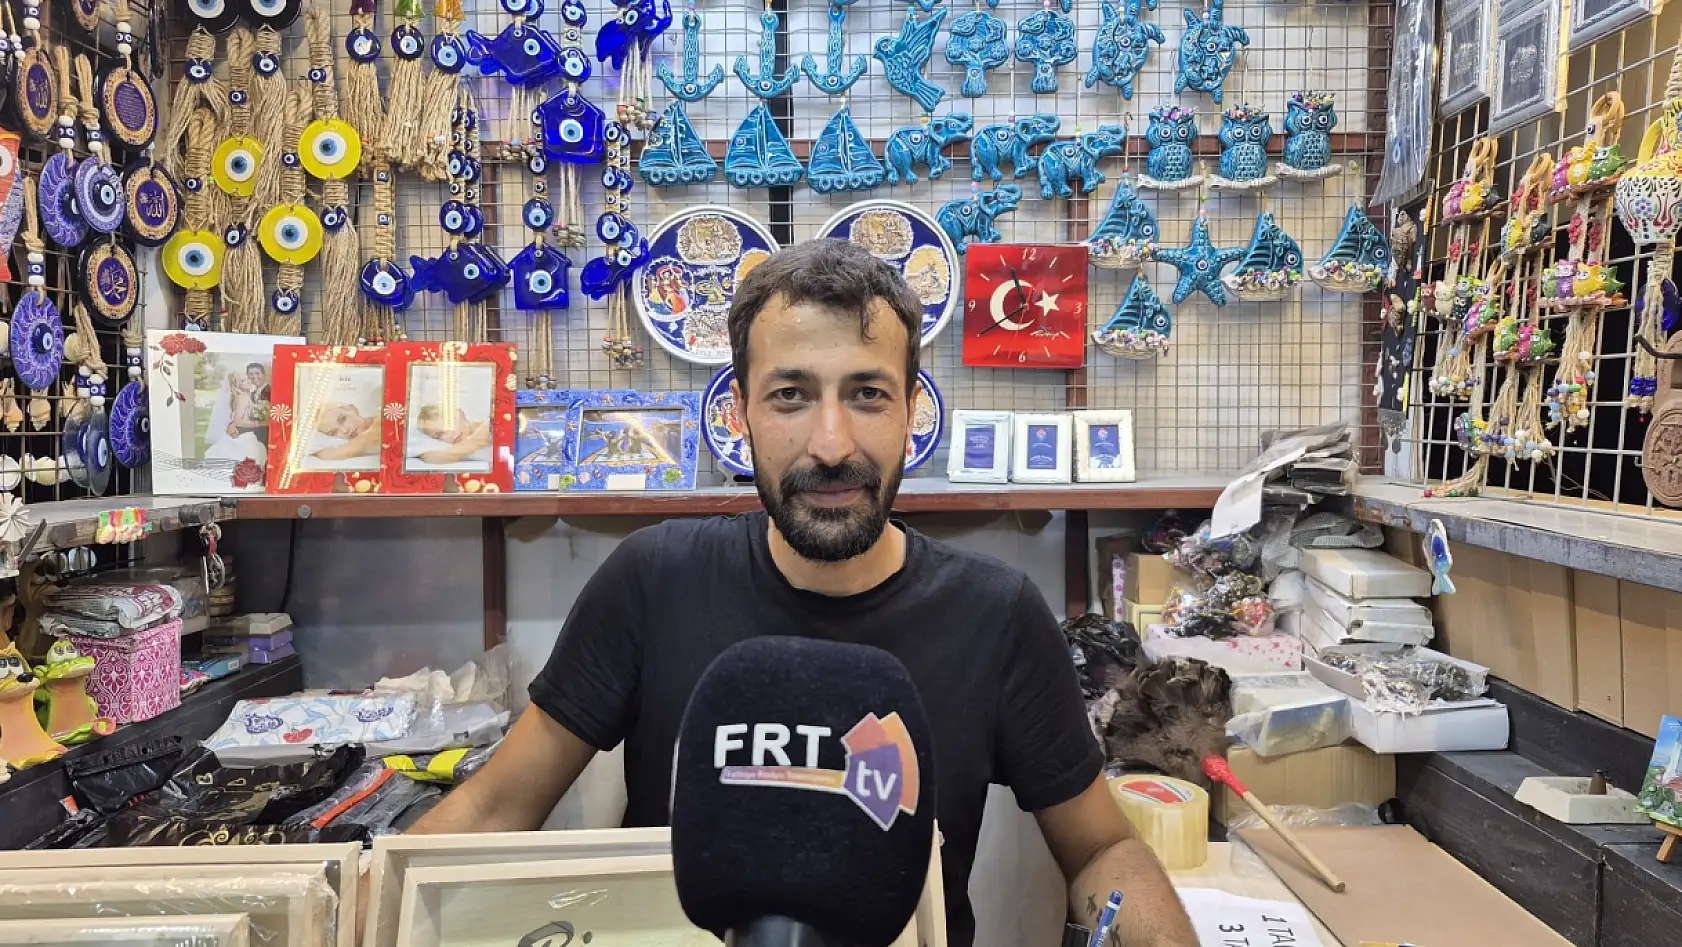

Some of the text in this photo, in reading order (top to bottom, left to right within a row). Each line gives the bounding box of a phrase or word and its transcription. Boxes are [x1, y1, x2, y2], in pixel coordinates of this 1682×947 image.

[1022, 248, 1037, 261] 12
[968, 299, 977, 312] 9
[1074, 302, 1083, 314] 3
[1018, 351, 1027, 363] 6
[714, 723, 832, 769] FRT
[855, 760, 897, 800] tv
[1218, 924, 1245, 932] 3
[1261, 914, 1297, 947] 1 TA
